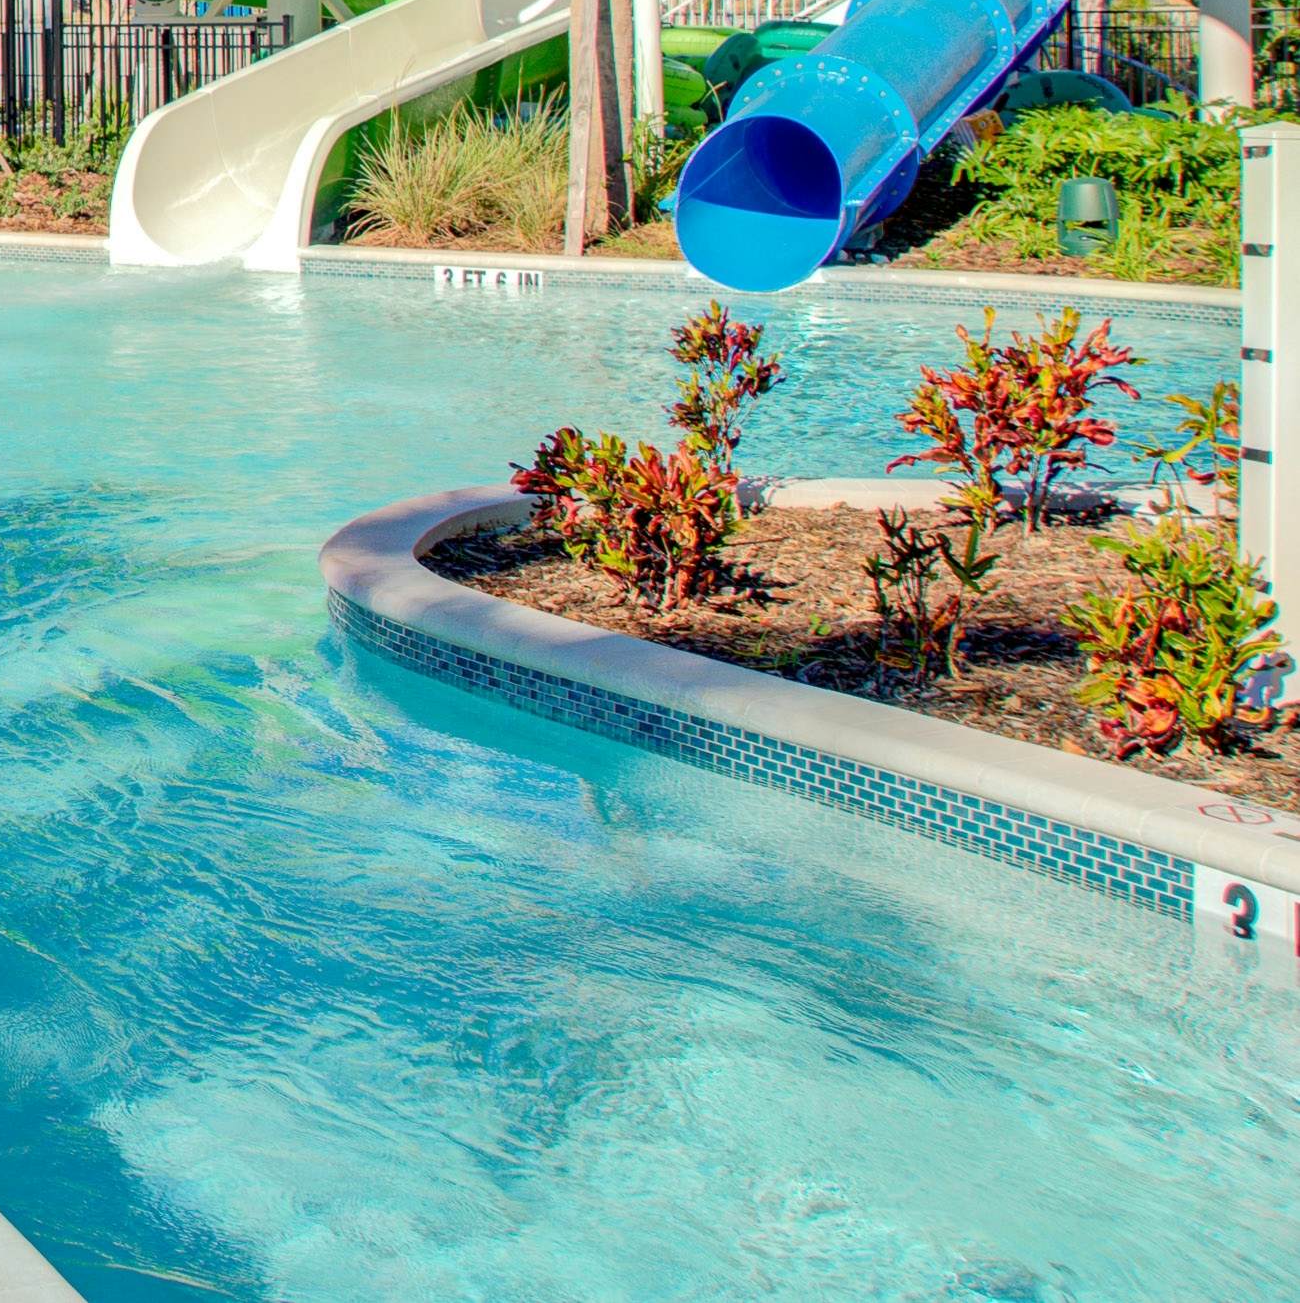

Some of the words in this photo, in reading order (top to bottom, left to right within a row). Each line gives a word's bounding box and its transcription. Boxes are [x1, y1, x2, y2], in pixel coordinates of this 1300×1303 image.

[443, 268, 453, 283] 3
[463, 269, 486, 284] FT
[517, 272, 539, 286] IN
[1223, 882, 1259, 940] 3
